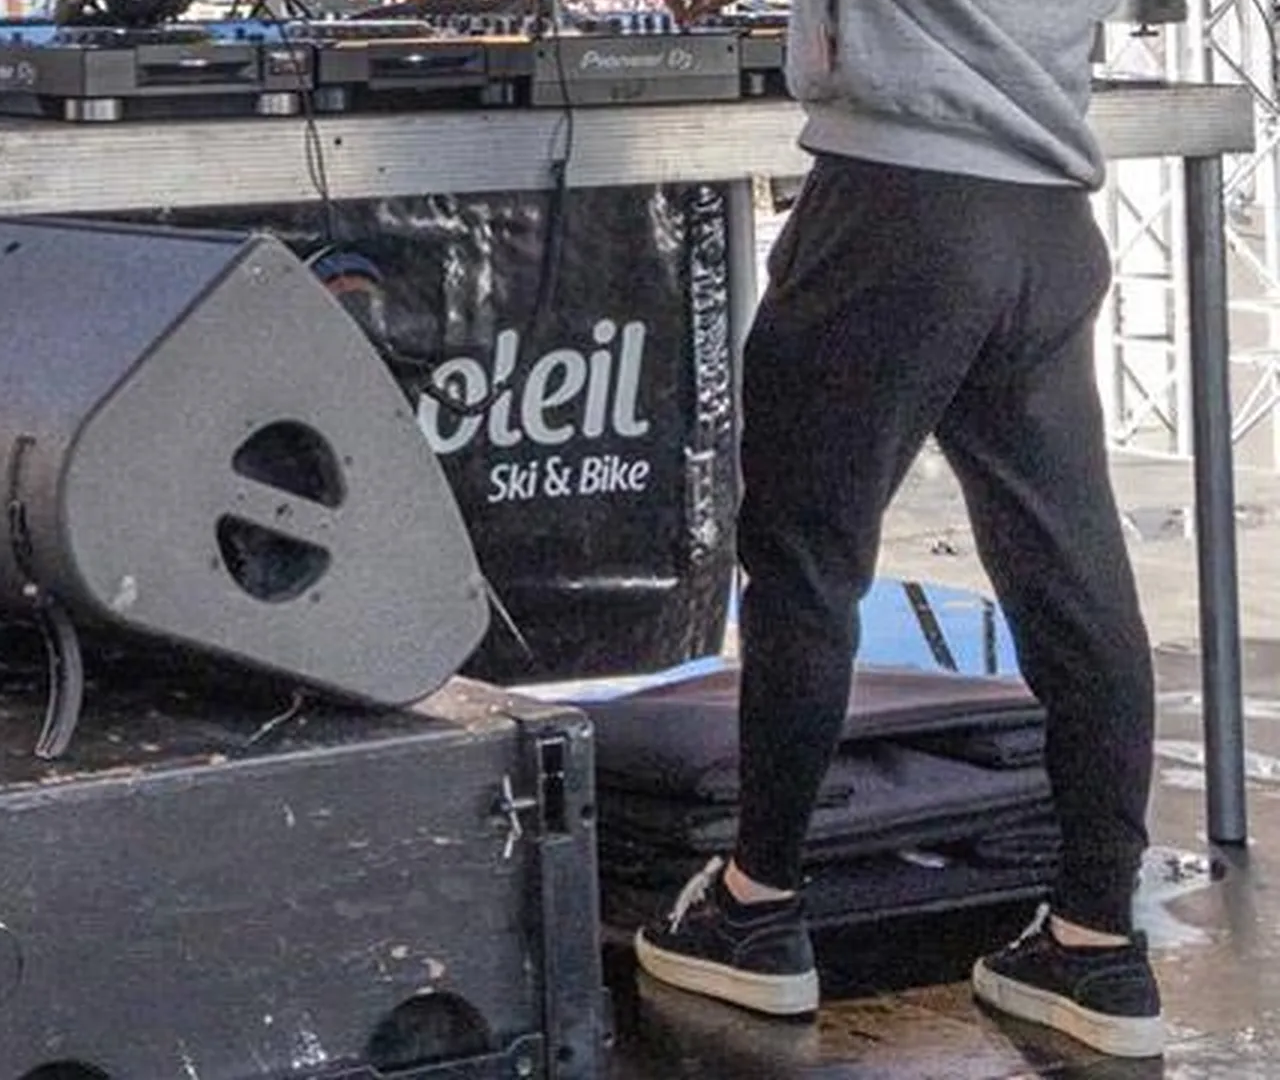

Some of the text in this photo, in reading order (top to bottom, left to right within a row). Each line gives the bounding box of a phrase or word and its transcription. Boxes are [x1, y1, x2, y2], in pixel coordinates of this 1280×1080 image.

[417, 319, 650, 454] oleil
[488, 454, 650, 503] Ski & Bike
